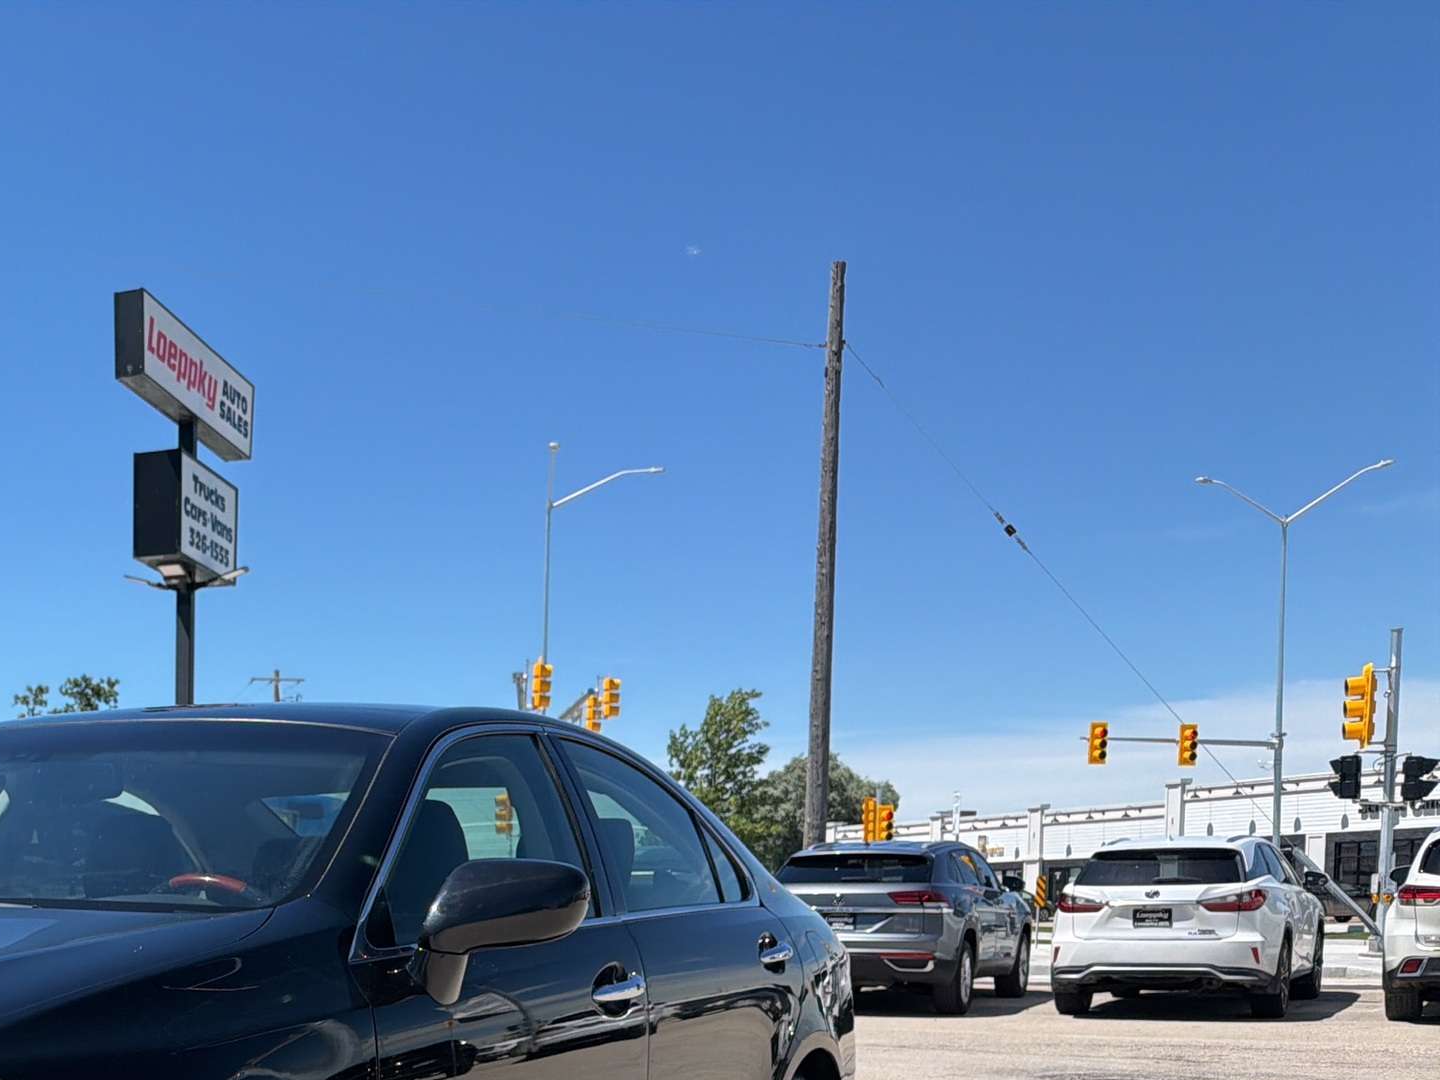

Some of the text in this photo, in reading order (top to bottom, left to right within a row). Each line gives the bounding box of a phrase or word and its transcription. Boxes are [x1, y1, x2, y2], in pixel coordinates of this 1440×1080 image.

[147, 315, 219, 412] Loeppky
[222, 379, 248, 415] AUTO
[219, 401, 249, 439] SALES
[192, 472, 226, 513] Trucks
